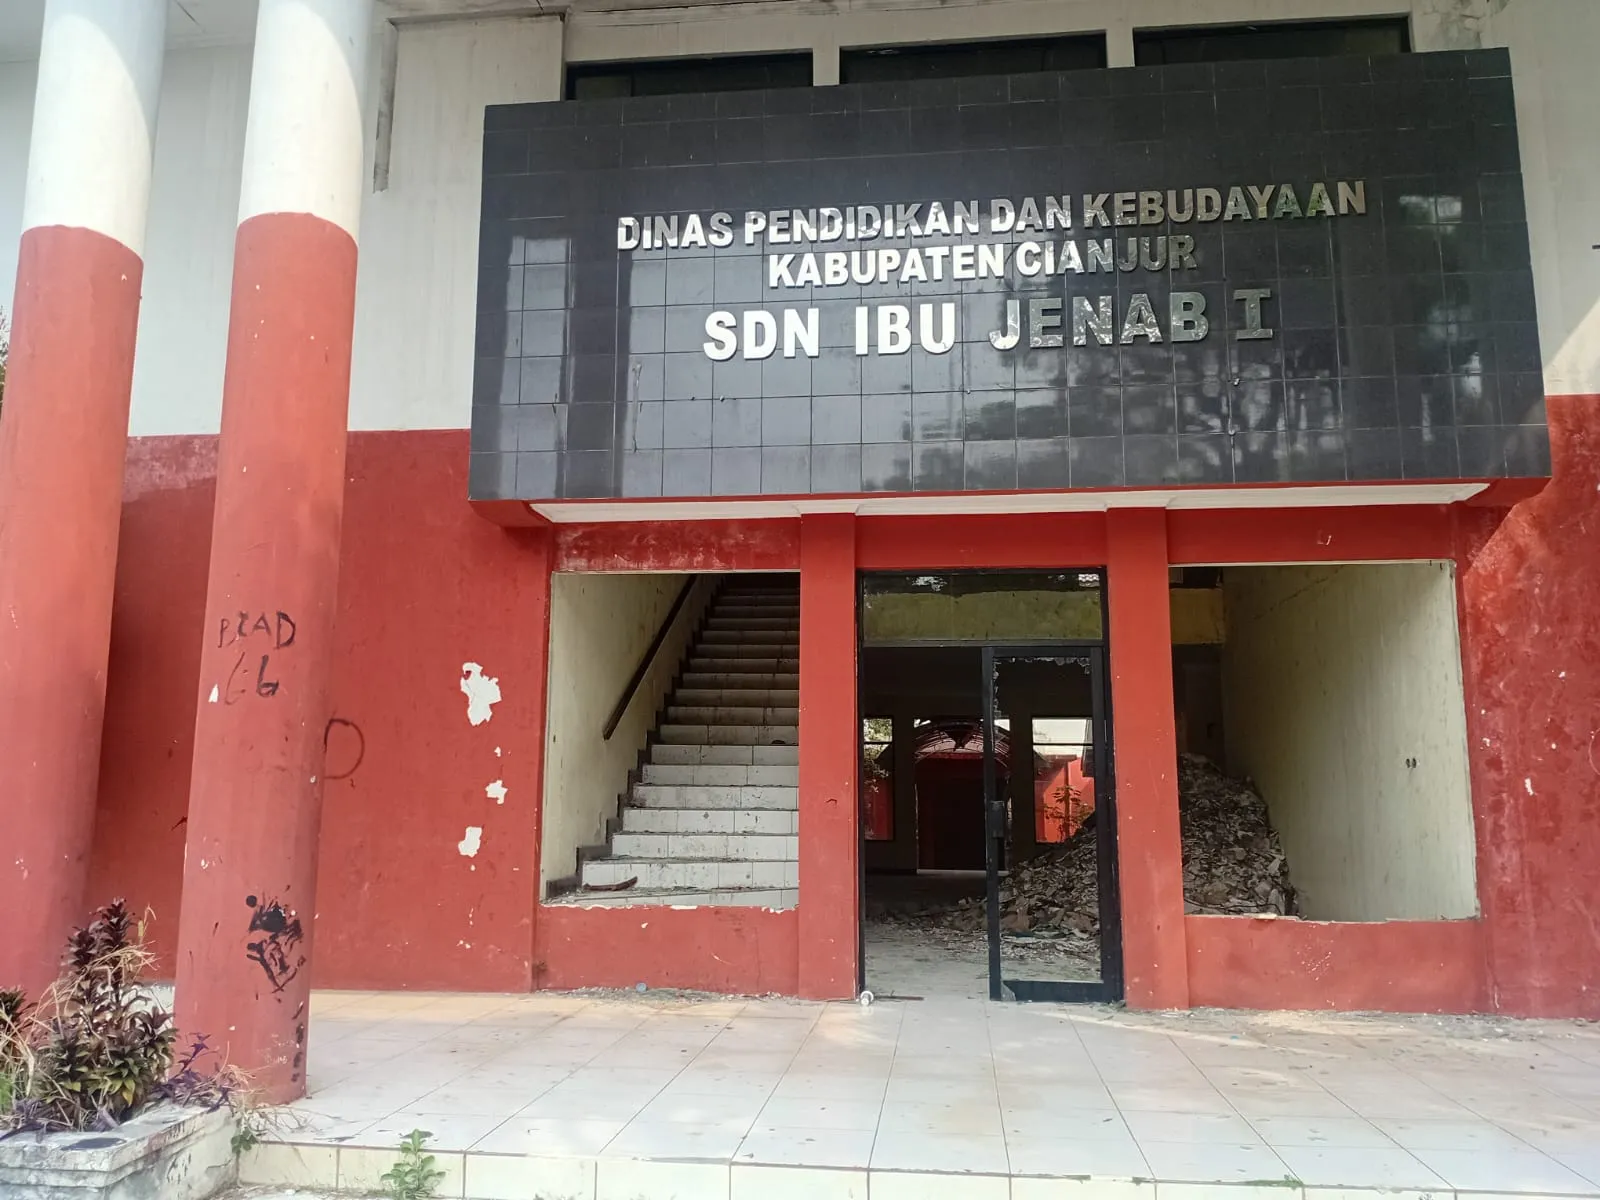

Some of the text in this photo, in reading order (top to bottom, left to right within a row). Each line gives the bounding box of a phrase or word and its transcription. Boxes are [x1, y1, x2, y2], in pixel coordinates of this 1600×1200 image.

[617, 180, 1368, 251] DINAS PENDIDIKAN DAN KEBUDAYAAN
[768, 234, 1198, 288] KABUPATEN CIANJUR
[703, 288, 1274, 362] SDN IBU JENAB I
